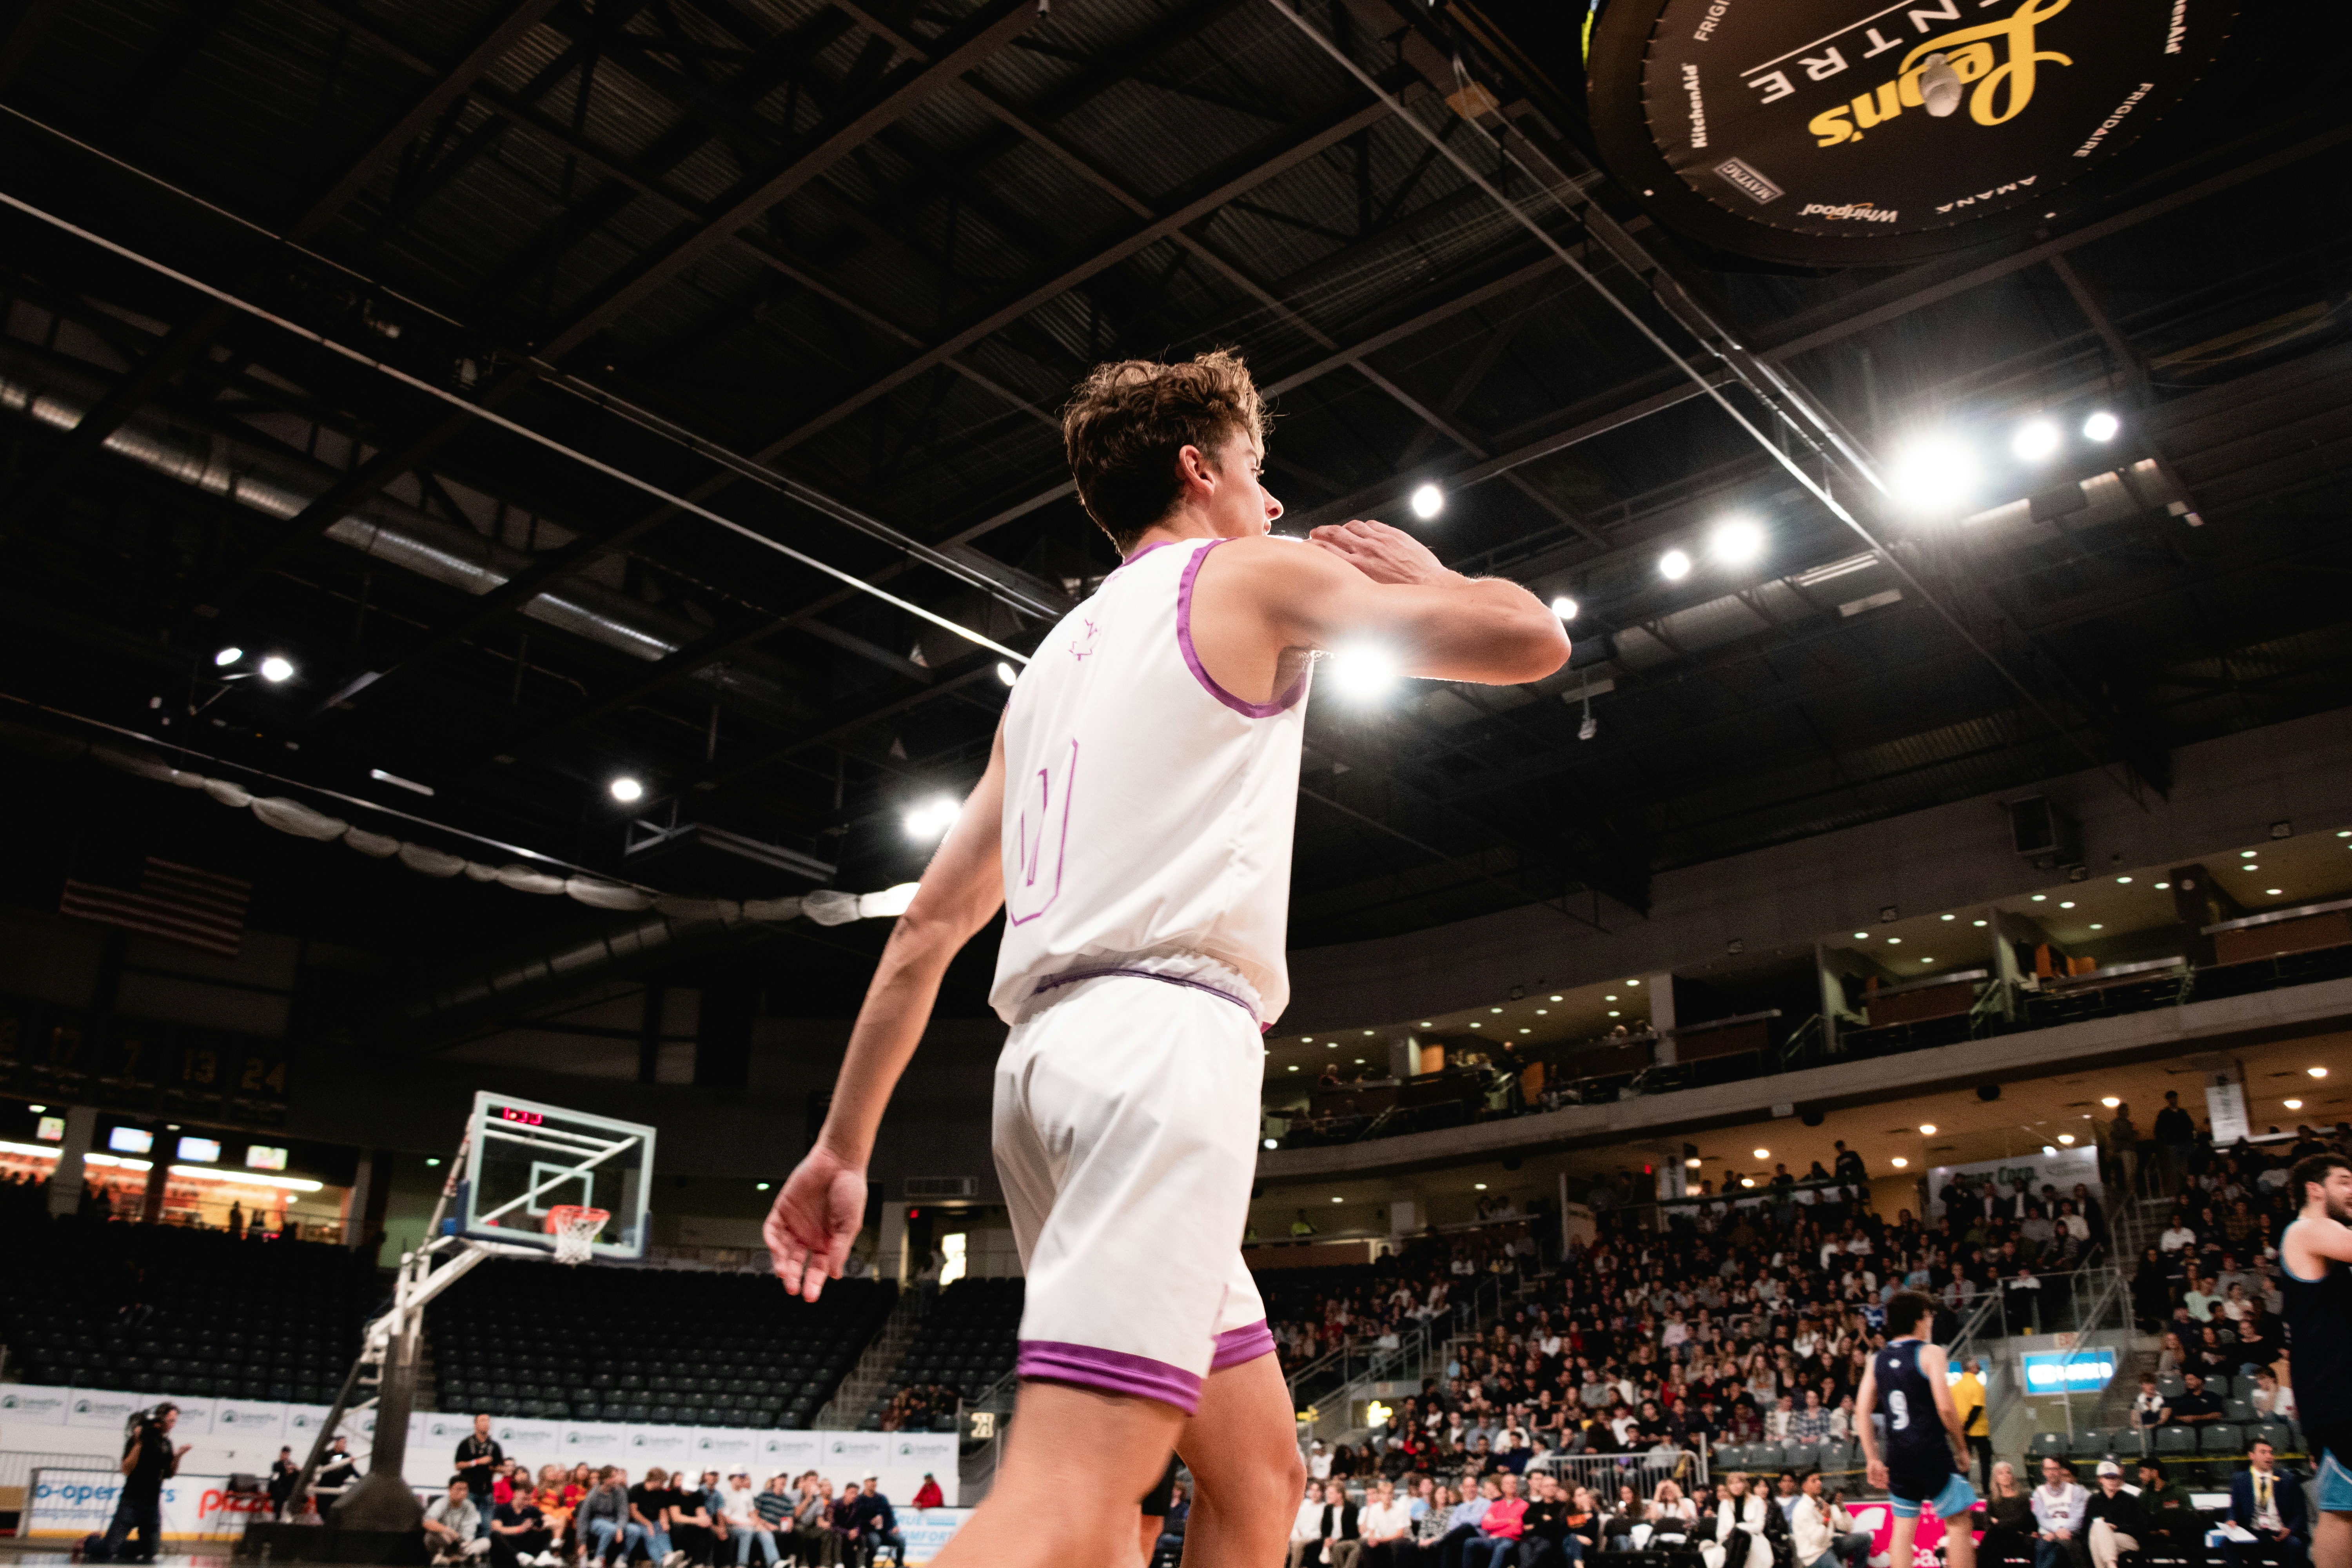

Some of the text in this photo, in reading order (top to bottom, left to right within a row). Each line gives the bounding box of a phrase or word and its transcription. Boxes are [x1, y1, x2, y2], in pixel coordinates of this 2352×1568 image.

[1747, 0, 2006, 104] NTRE
[1681, 63, 1708, 148] KitchenAid
[2072, 83, 2155, 157] FRIGIDAIRE
[1722, 163, 1773, 199] MAYTAG
[1935, 175, 2037, 214] AMANA
[1799, 203, 1898, 223] Whirlpool
[182, 1048, 217, 1084] 13
[241, 1057, 286, 1094] 24
[1888, 1390, 1909, 1430] 9
